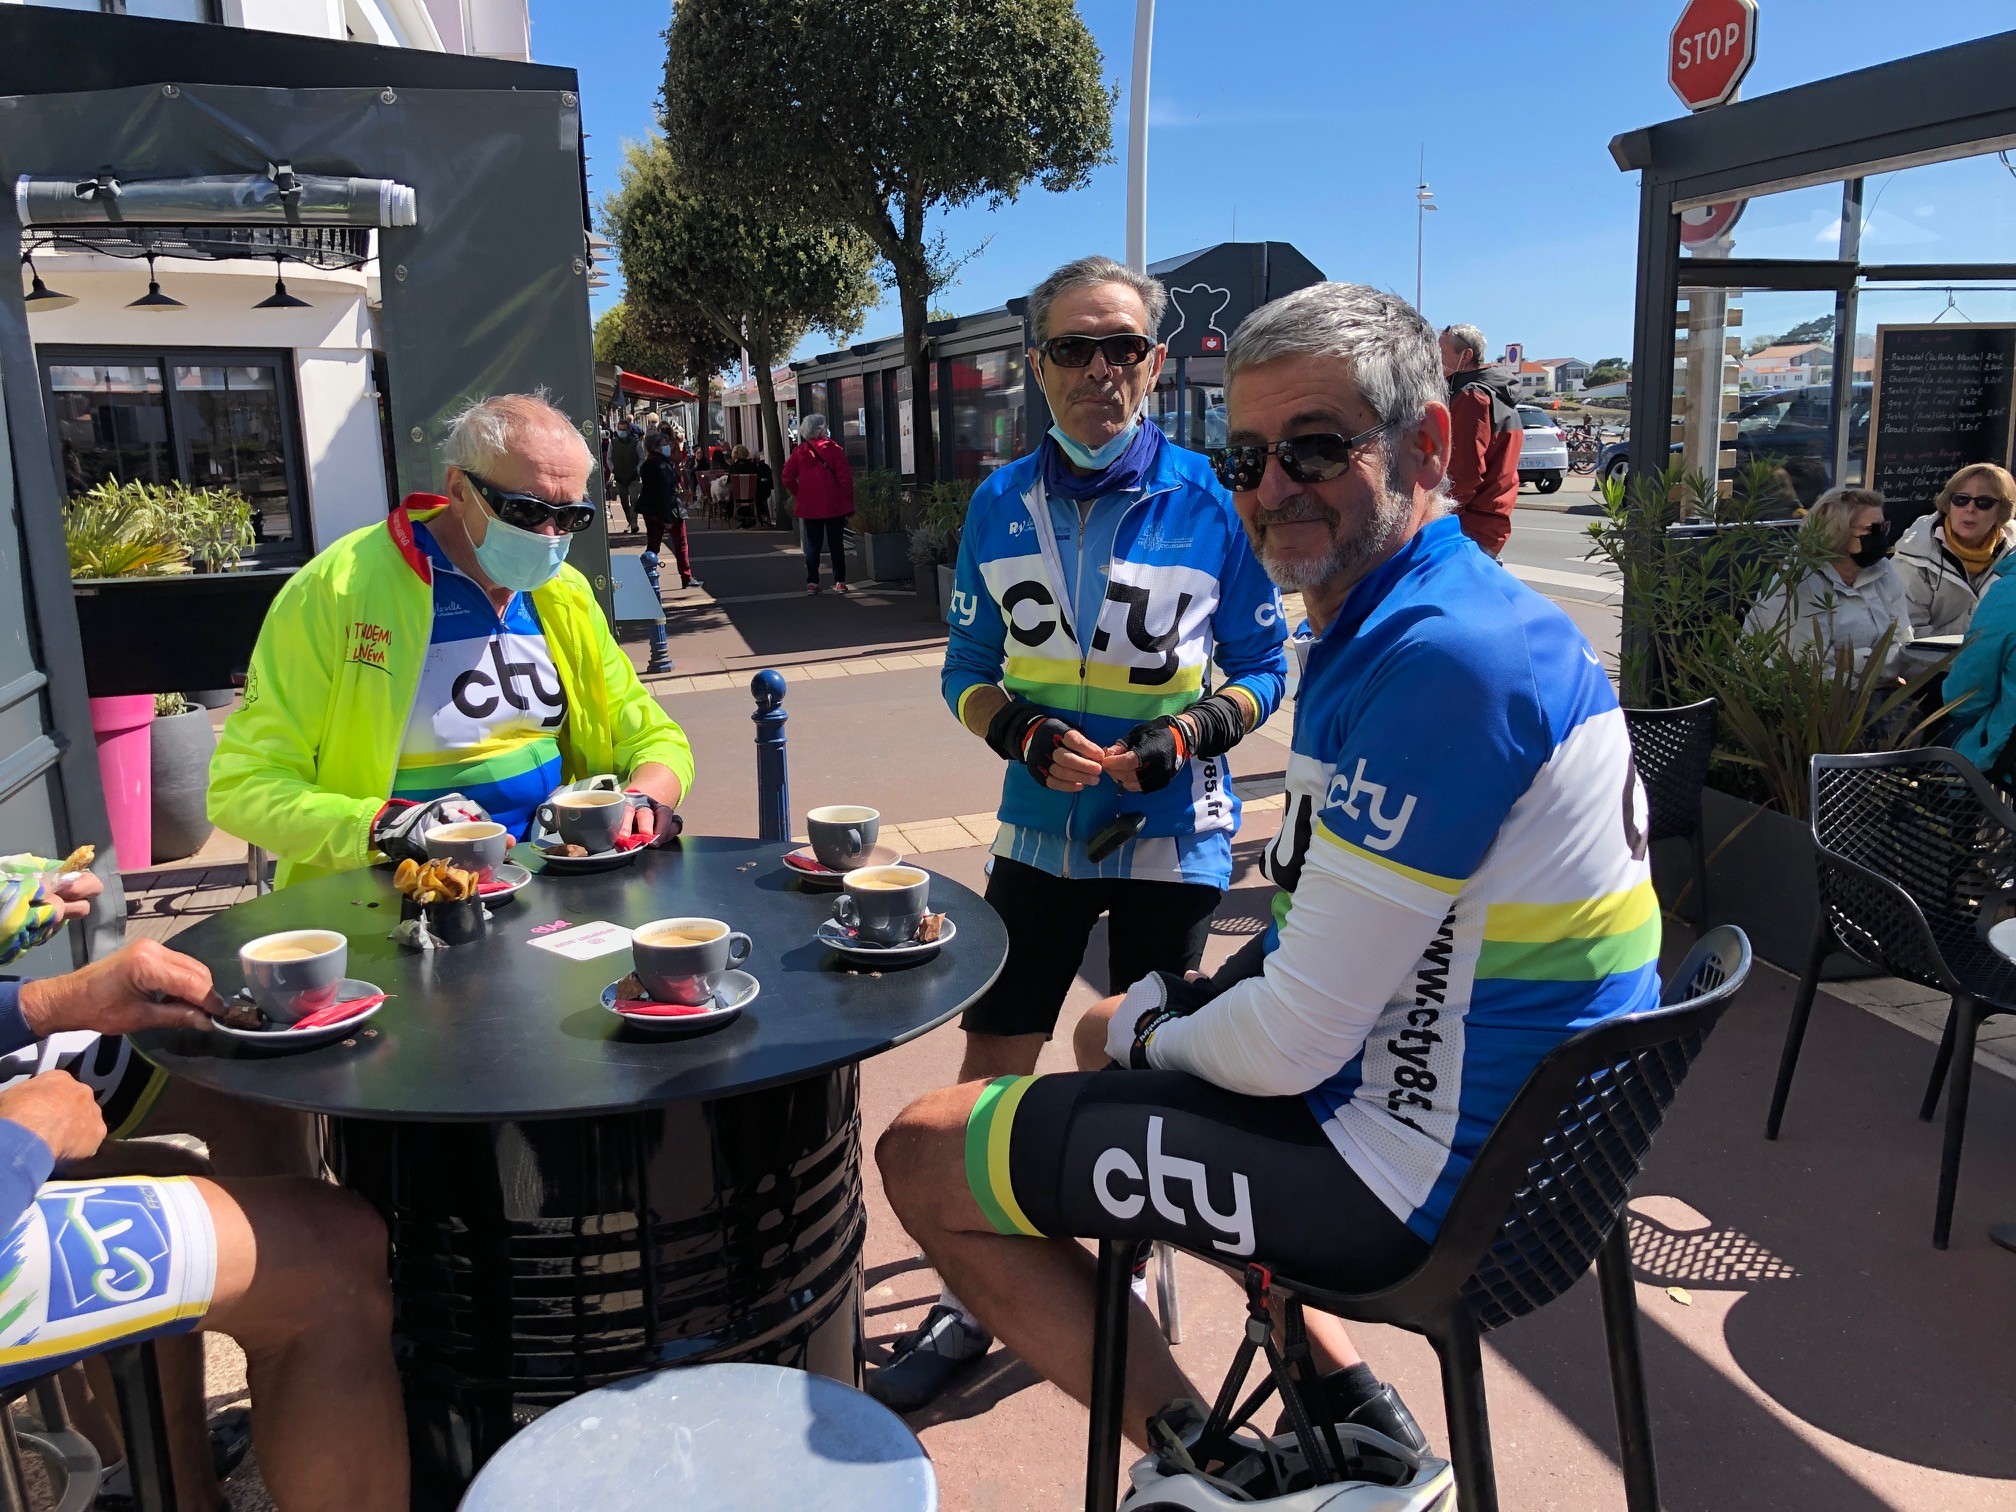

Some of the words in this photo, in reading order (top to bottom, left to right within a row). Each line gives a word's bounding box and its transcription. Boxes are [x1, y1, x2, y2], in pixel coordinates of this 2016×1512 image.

[1677, 22, 1740, 70] STOP
[451, 640, 569, 727] cty
[1326, 758, 1418, 851] cty
[1092, 1114, 1256, 1256] cty
